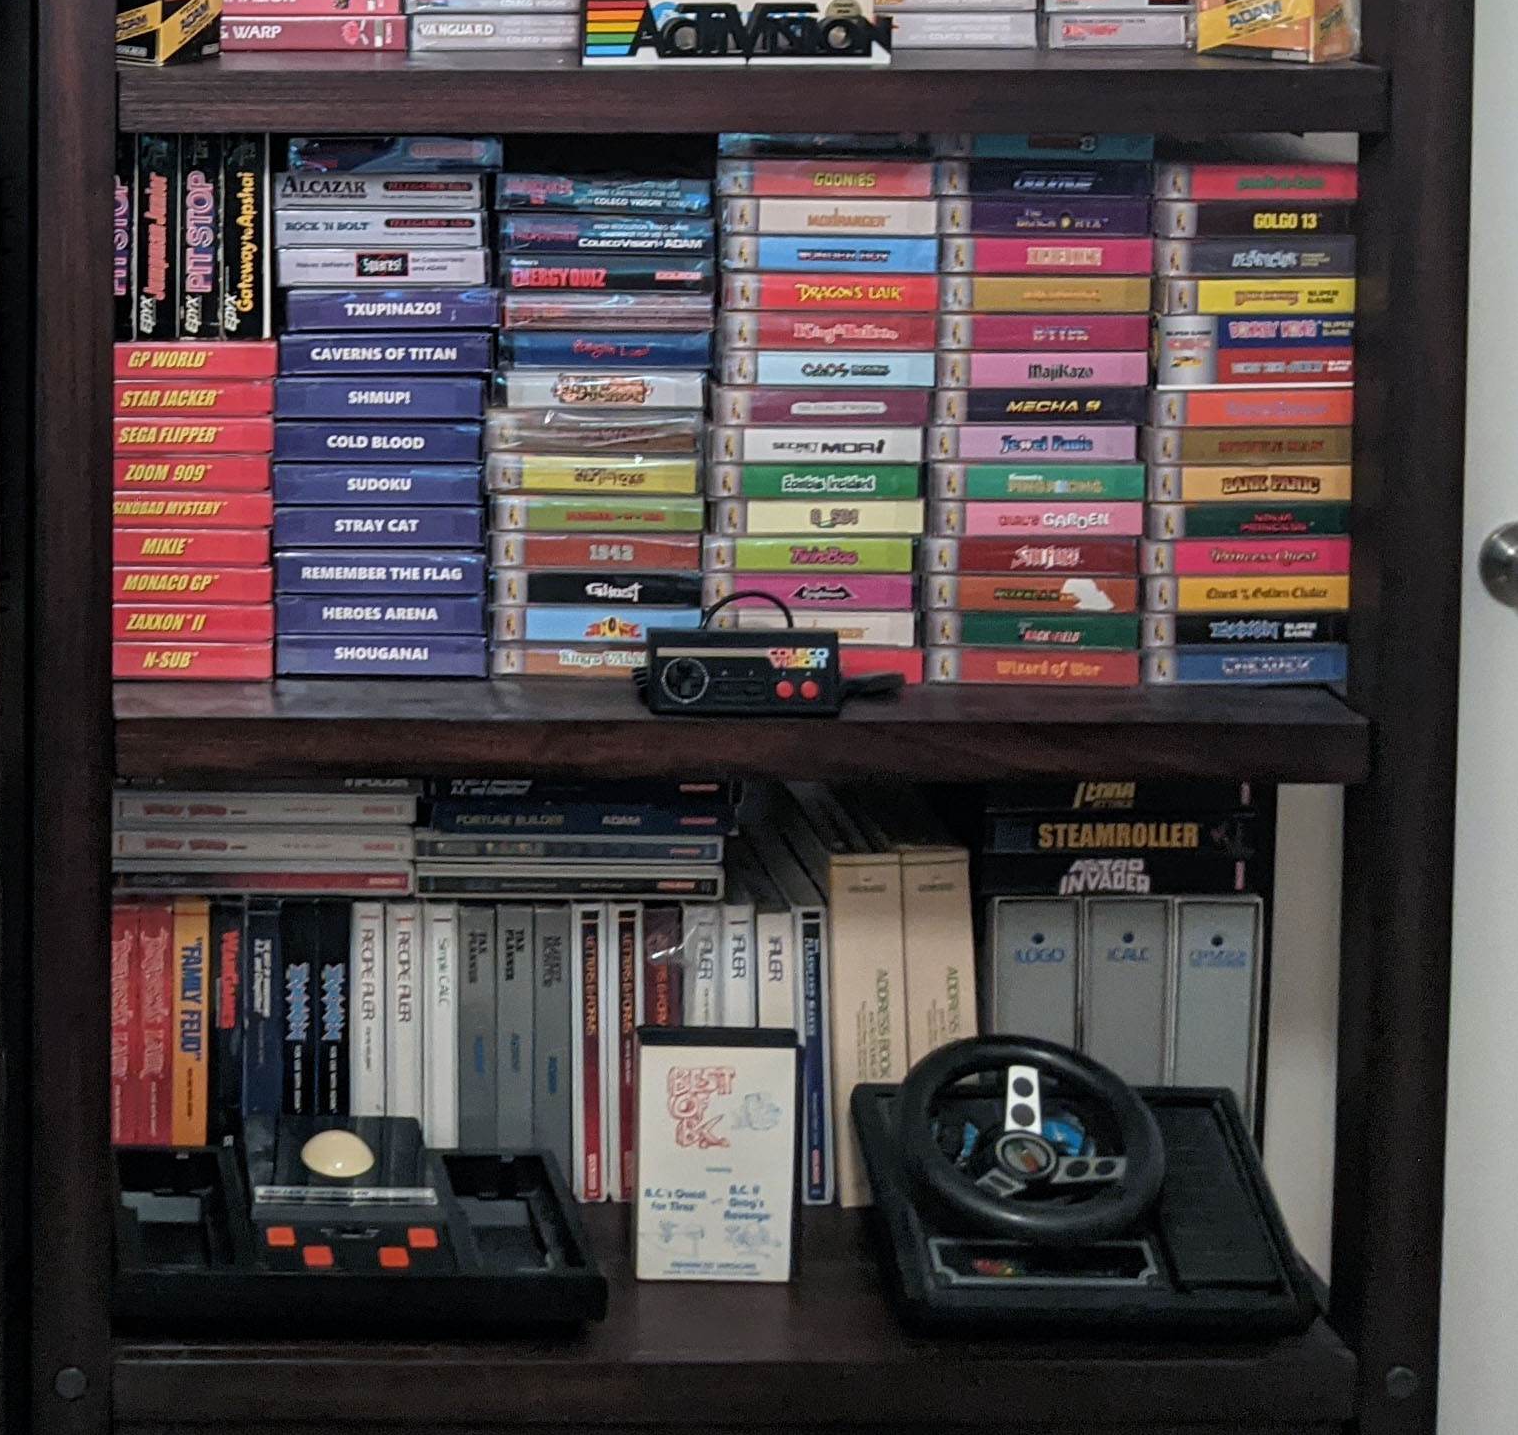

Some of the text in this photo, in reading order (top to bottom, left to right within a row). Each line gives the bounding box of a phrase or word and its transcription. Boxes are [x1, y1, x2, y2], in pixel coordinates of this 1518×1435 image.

[1228, 0, 1282, 29] ADAM
[233, 26, 281, 39] WARP
[418, 23, 495, 36] VANGUARD
[281, 177, 366, 194] ALCAZAR
[1253, 214, 1317, 229] GOLGO 13
[236, 172, 258, 312] Gateway Apshai
[511, 269, 607, 287] ENERGY QUIZ
[345, 303, 441, 316] TXUPINAZO!
[129, 351, 206, 367] GP WORLD
[311, 348, 457, 361] CAVERNS OF TITAN
[121, 391, 215, 407] STAR JACKER
[348, 391, 410, 404] SHMUP!
[1006, 400, 1080, 414] MECHA
[120, 427, 217, 443] SEGA FLIPPER
[327, 435, 424, 449] COLD BLOOD
[124, 465, 206, 481] ZOOM 909
[348, 479, 411, 491] SUDOKU
[1222, 476, 1321, 494] BANK PANIC
[335, 520, 418, 532] STRAY CAT
[141, 539, 185, 555] MIKIE
[590, 546, 634, 560] 1942
[301, 567, 462, 580] REMEMBER THE FLAG
[123, 575, 212, 591] MONACO GP
[323, 608, 437, 620] HEROES ARENA
[144, 653, 191, 669] N-SUB
[334, 648, 429, 660] SHOUGANAI
[1038, 823, 1200, 849] STEAMROLLER
